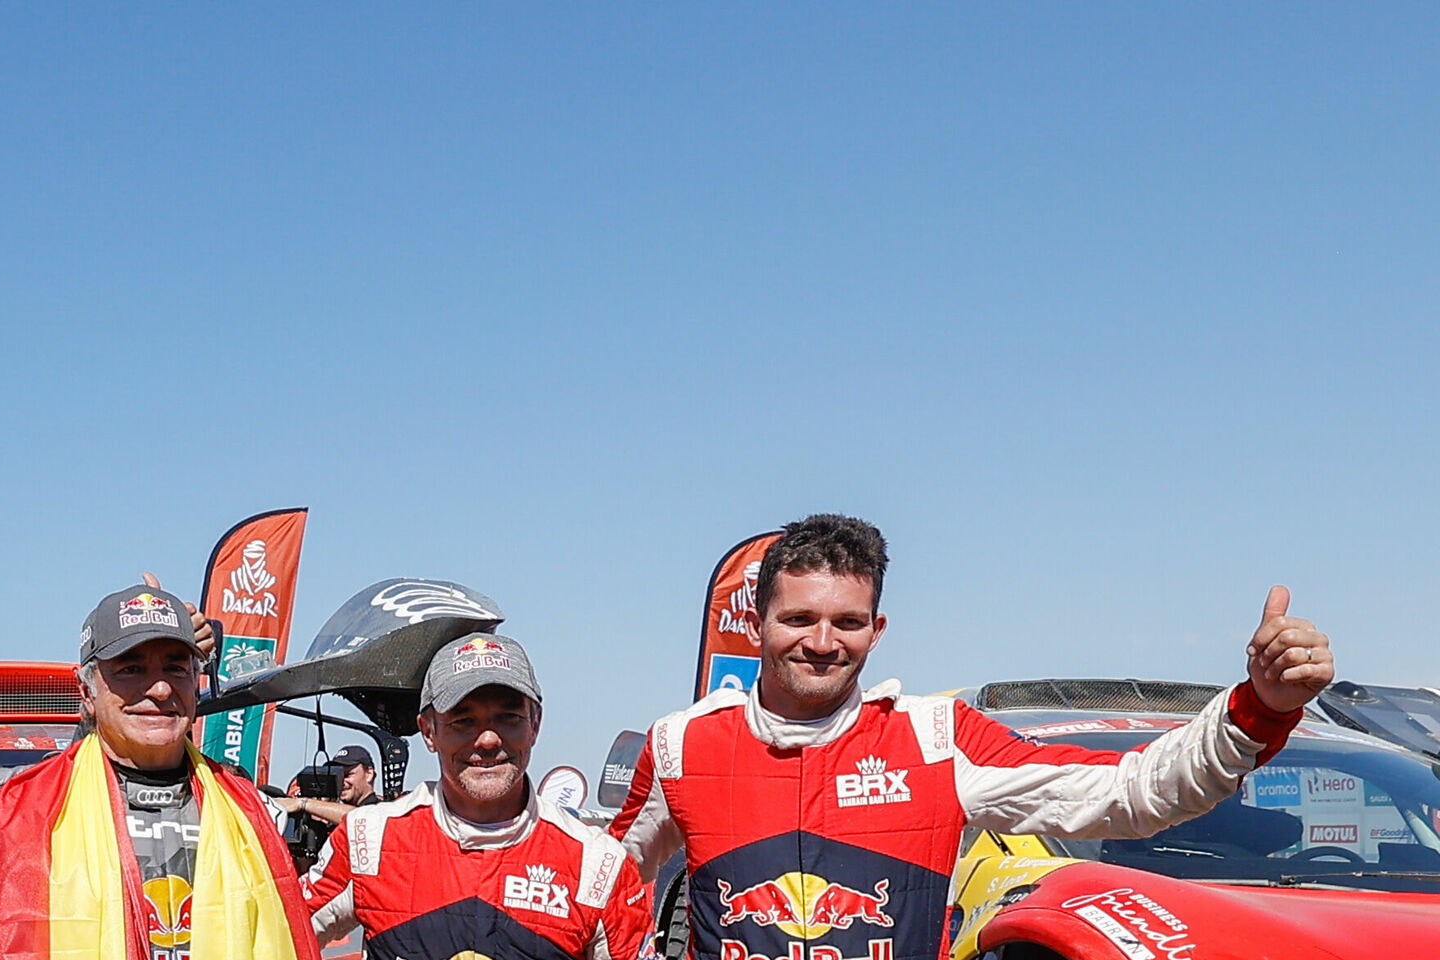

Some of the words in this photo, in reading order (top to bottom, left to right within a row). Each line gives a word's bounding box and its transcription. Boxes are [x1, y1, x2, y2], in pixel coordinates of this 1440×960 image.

[222, 588, 278, 618] DAKAR
[119, 610, 150, 629] Red
[151, 611, 179, 628] Bull
[718, 608, 747, 634] DAK
[453, 655, 480, 675] Red
[482, 655, 511, 670] Bull
[224, 708, 245, 768] ABIA
[1026, 721, 1107, 738] MOTUL
[835, 769, 911, 798] BRX
[1257, 784, 1299, 797] aramco
[354, 818, 370, 866] sparco
[1312, 827, 1357, 842] MOTUL
[504, 874, 570, 910] BRX
[1129, 894, 1189, 932] BUSINESS
